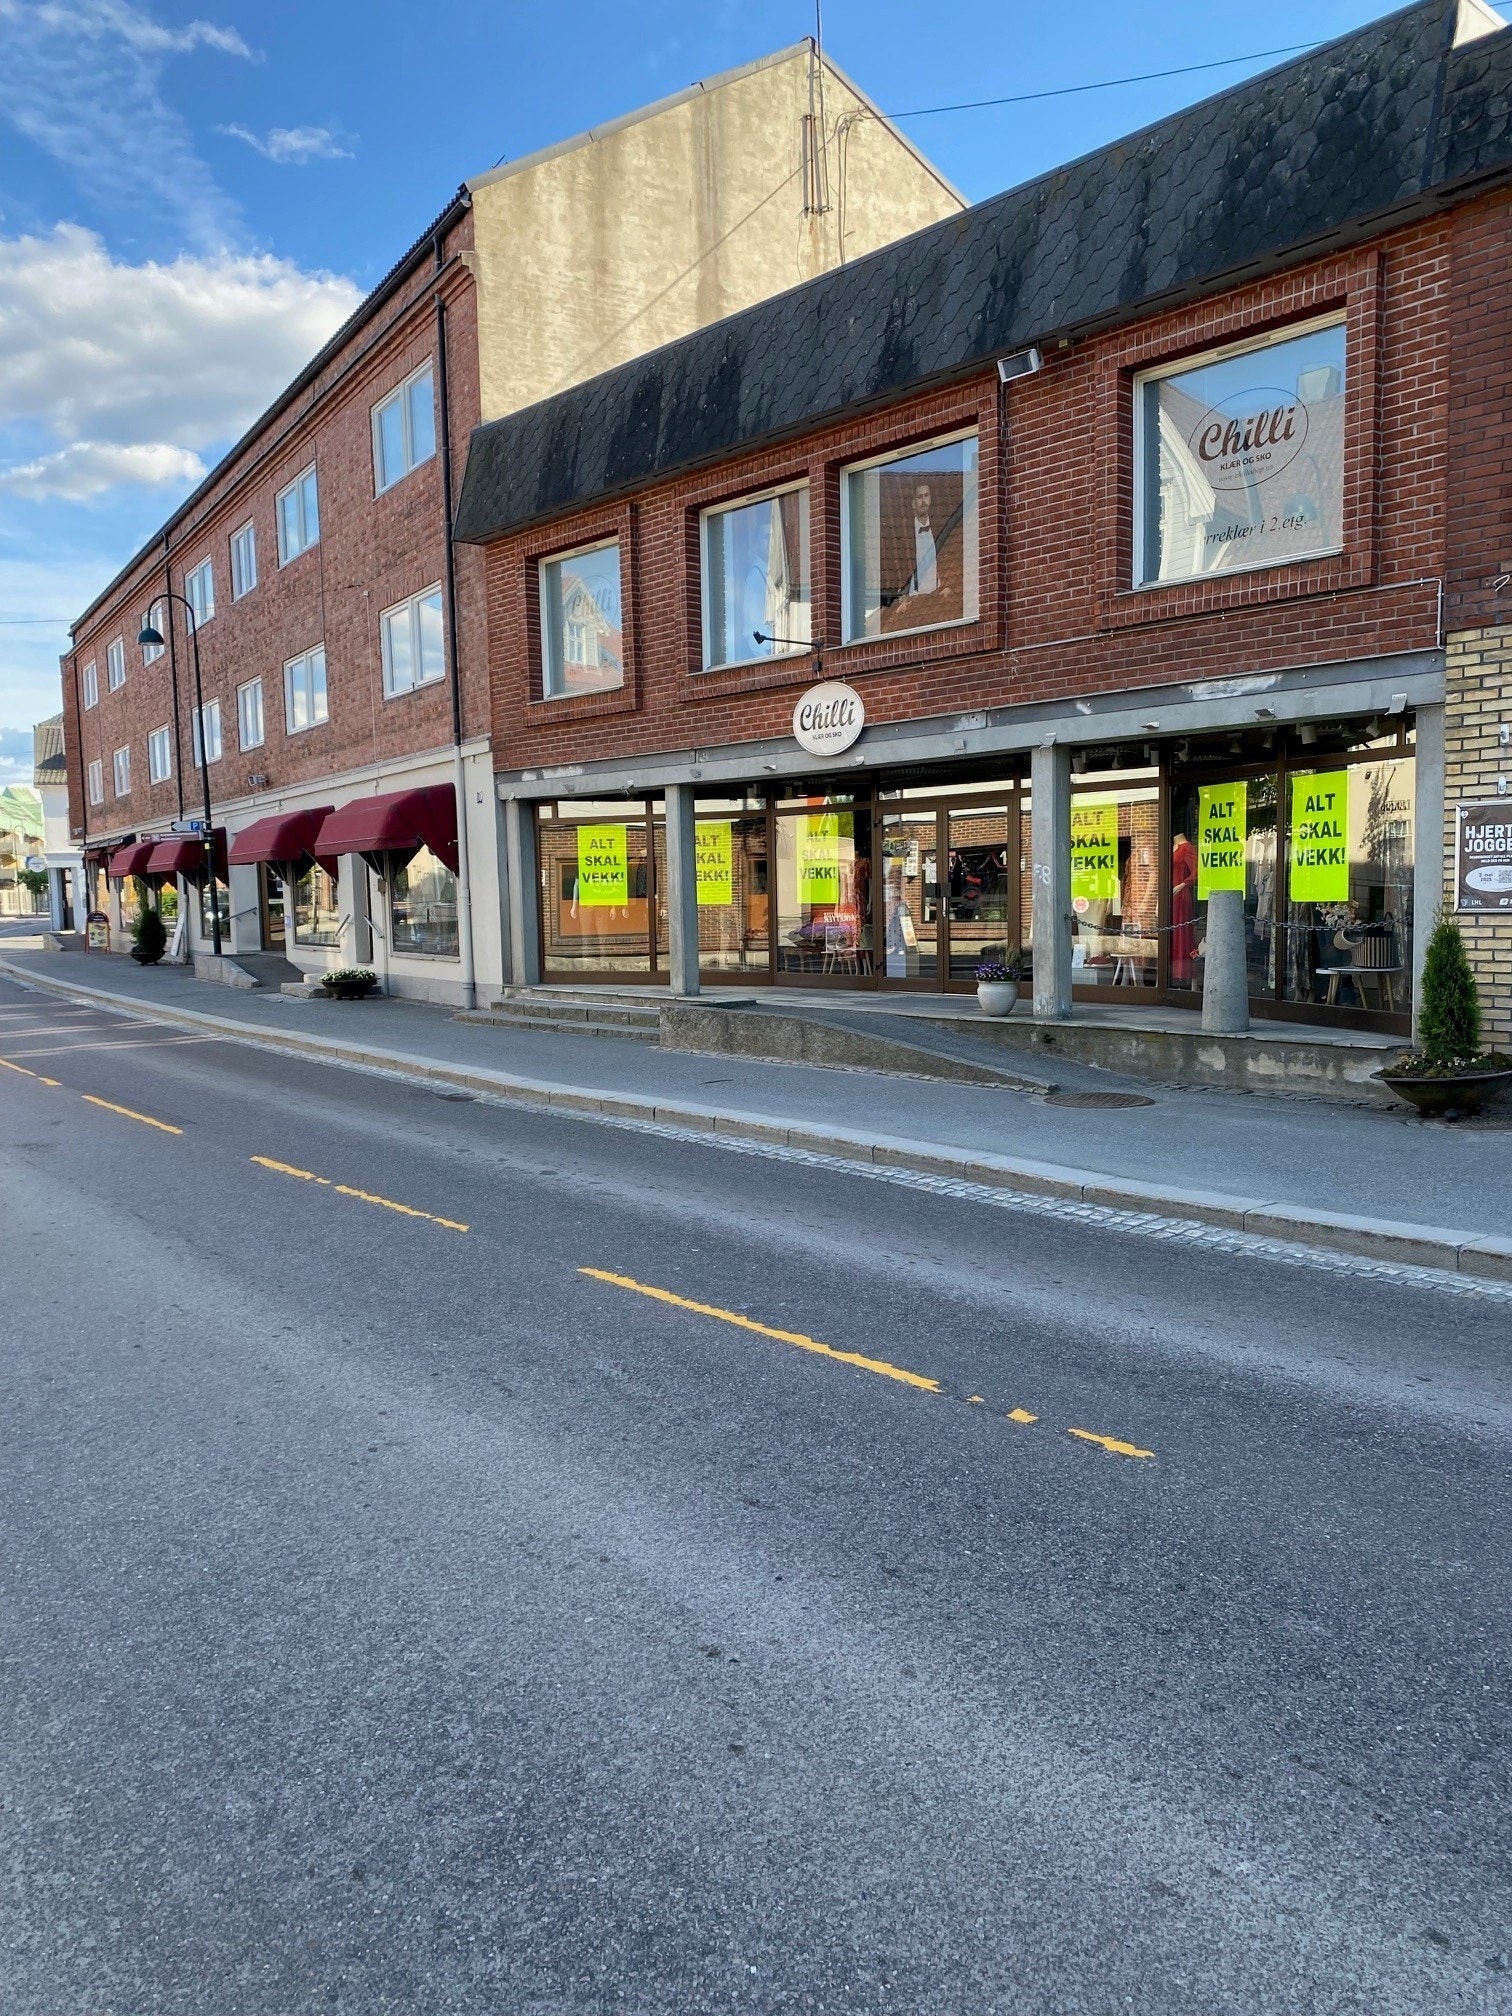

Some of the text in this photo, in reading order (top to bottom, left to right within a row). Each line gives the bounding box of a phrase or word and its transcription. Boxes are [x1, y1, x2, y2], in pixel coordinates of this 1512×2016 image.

[1199, 405, 1296, 462] Chilli
[1220, 452, 1272, 471] KLÆR OG SKO
[800, 699, 855, 731] Chilli
[1209, 802, 1235, 819] ALT
[1305, 793, 1336, 813] ALT
[1072, 811, 1104, 826] ALT
[806, 830, 829, 843] ALT
[1204, 826, 1240, 843] SKAL
[1299, 821, 1342, 840] SKAL
[589, 838, 615, 849] ALT
[585, 855, 621, 866] SKAL
[696, 852, 726, 864] KAL
[802, 849, 833, 862] SKAL
[1071, 855, 1115, 870] EKK!
[1201, 851, 1243, 868] VEKK!
[1297, 848, 1346, 867] VEKK!
[582, 872, 624, 883] VEKK!
[696, 870, 729, 882] EKK!
[800, 867, 836, 879] VEKK!
